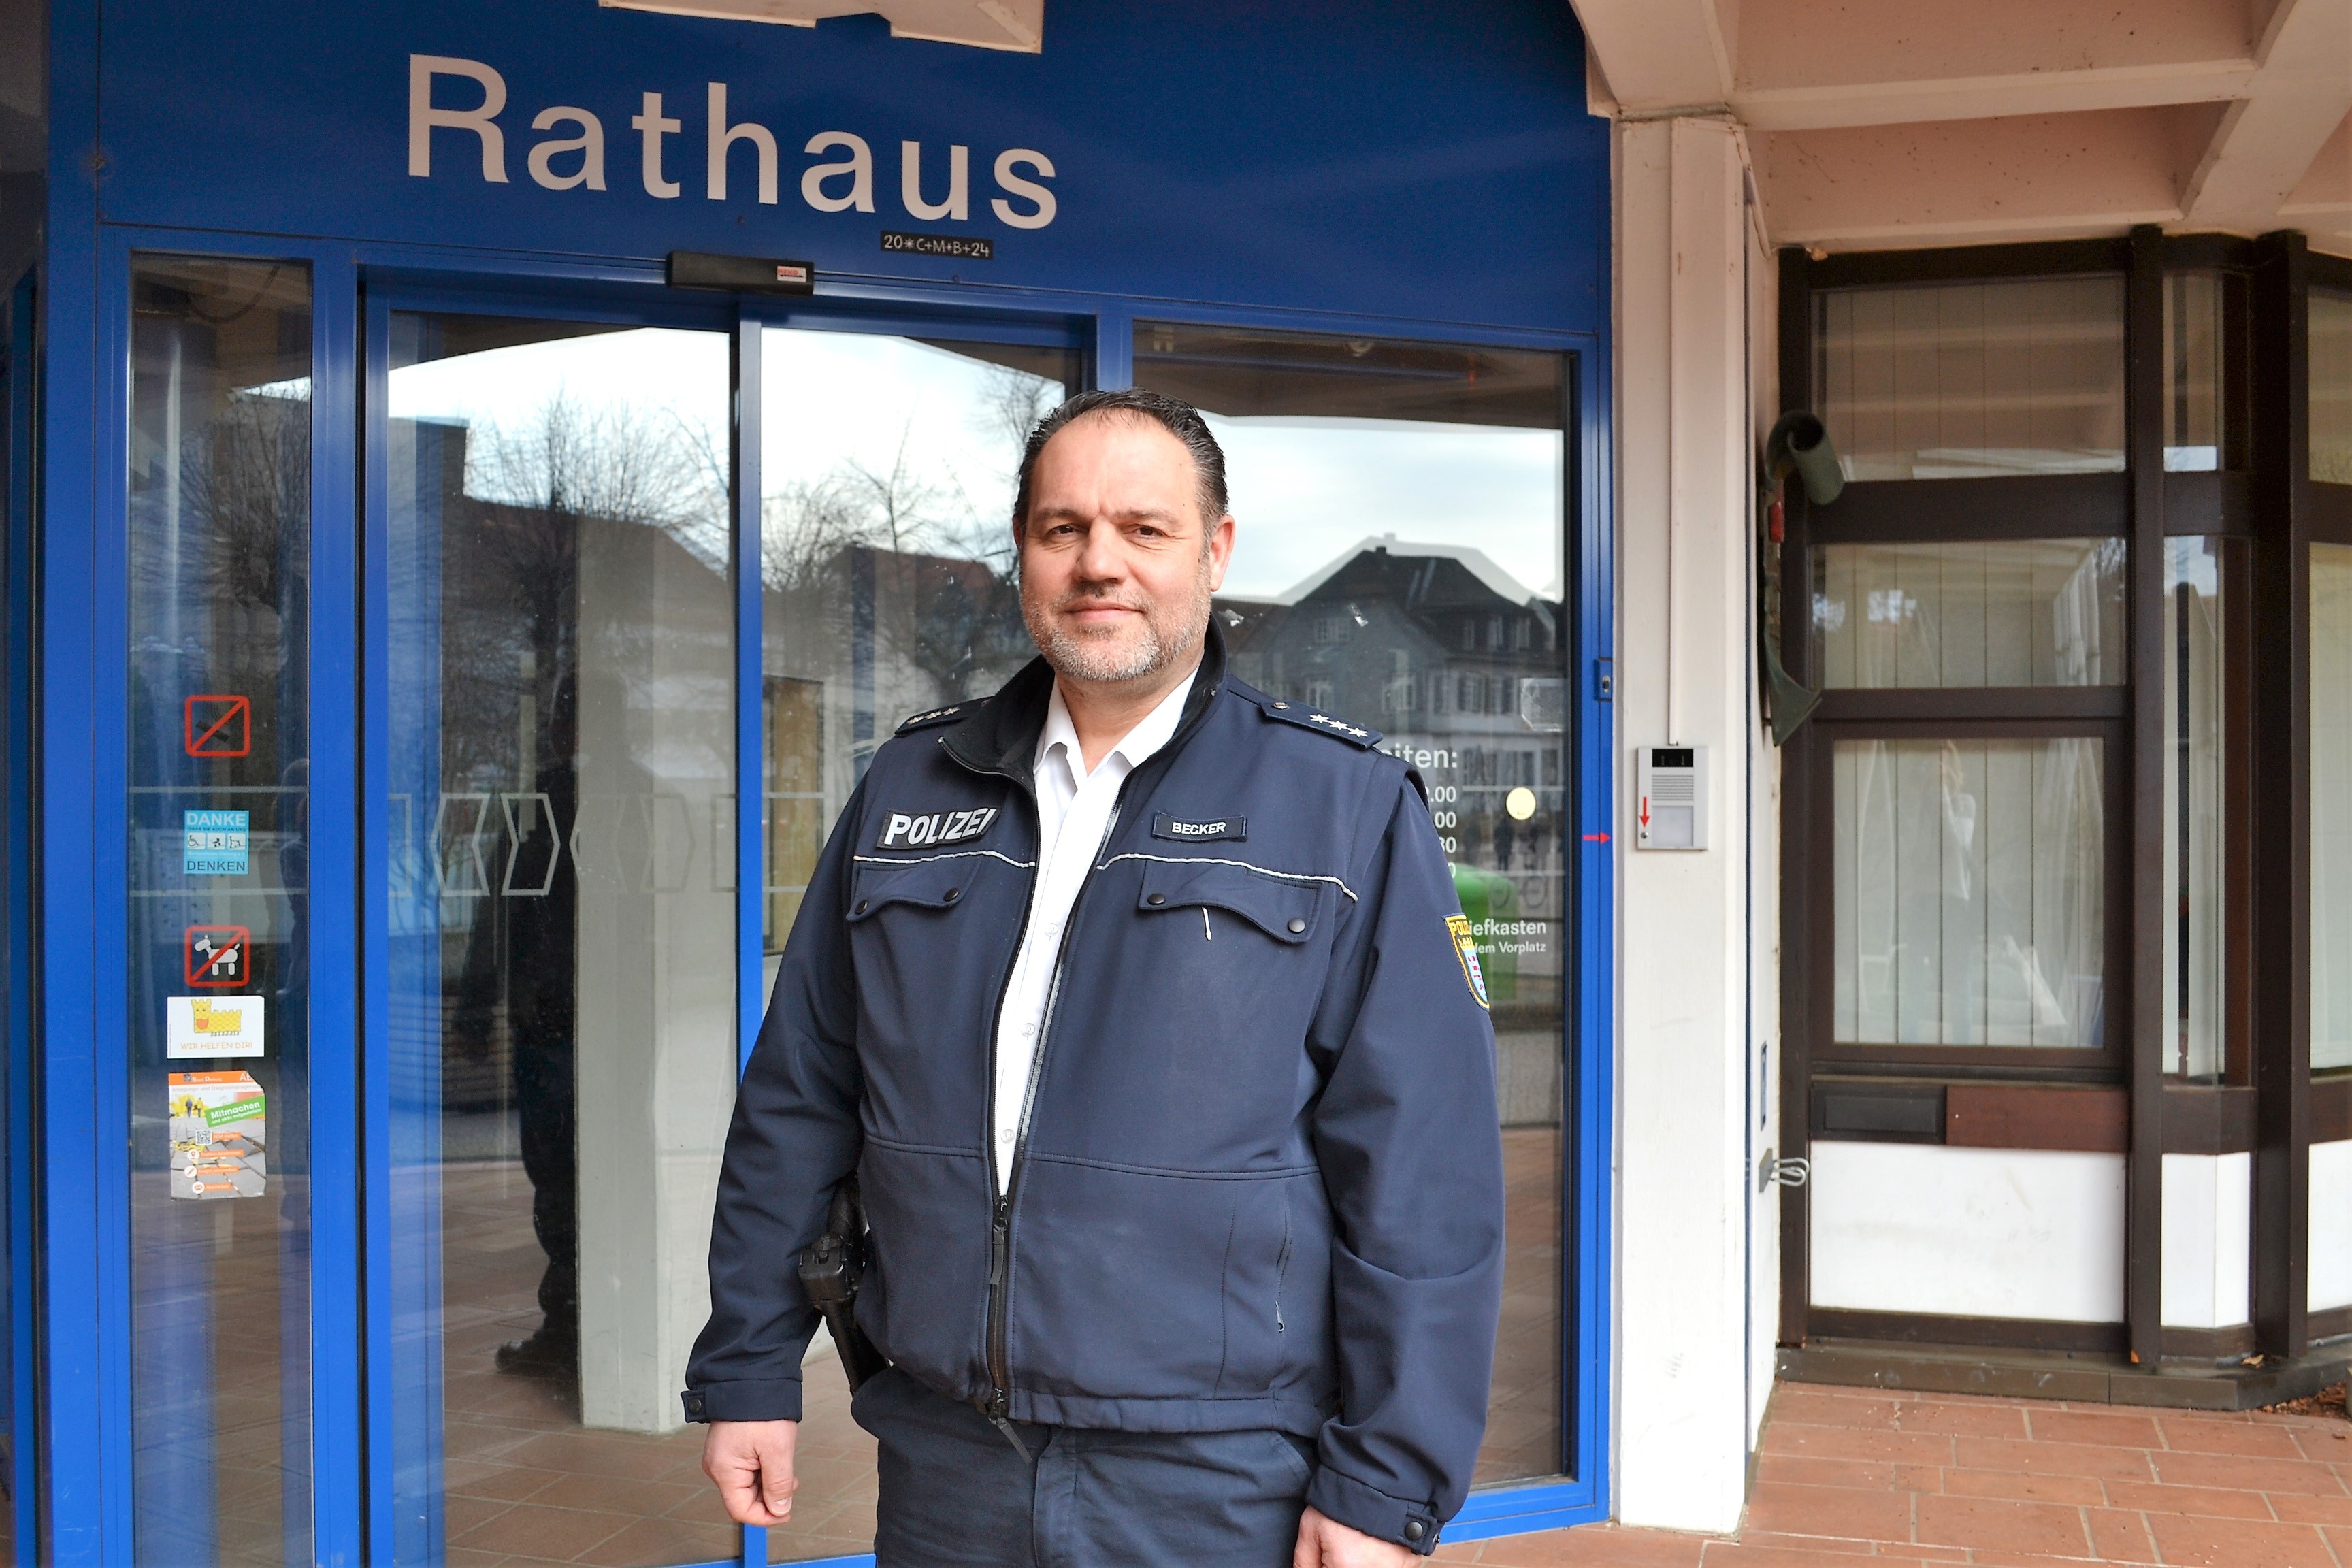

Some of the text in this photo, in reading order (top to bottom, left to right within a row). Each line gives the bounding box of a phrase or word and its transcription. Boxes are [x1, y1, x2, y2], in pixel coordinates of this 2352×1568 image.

[408, 54, 1056, 229] Rathaus
[187, 813, 246, 826] DANKE
[884, 808, 997, 845] POLIZEI
[1172, 822, 1226, 835] BECKER
[187, 861, 245, 871] DENKEN
[1499, 941, 1546, 955] Vorplatz
[210, 1102, 260, 1119] Mitmachen
